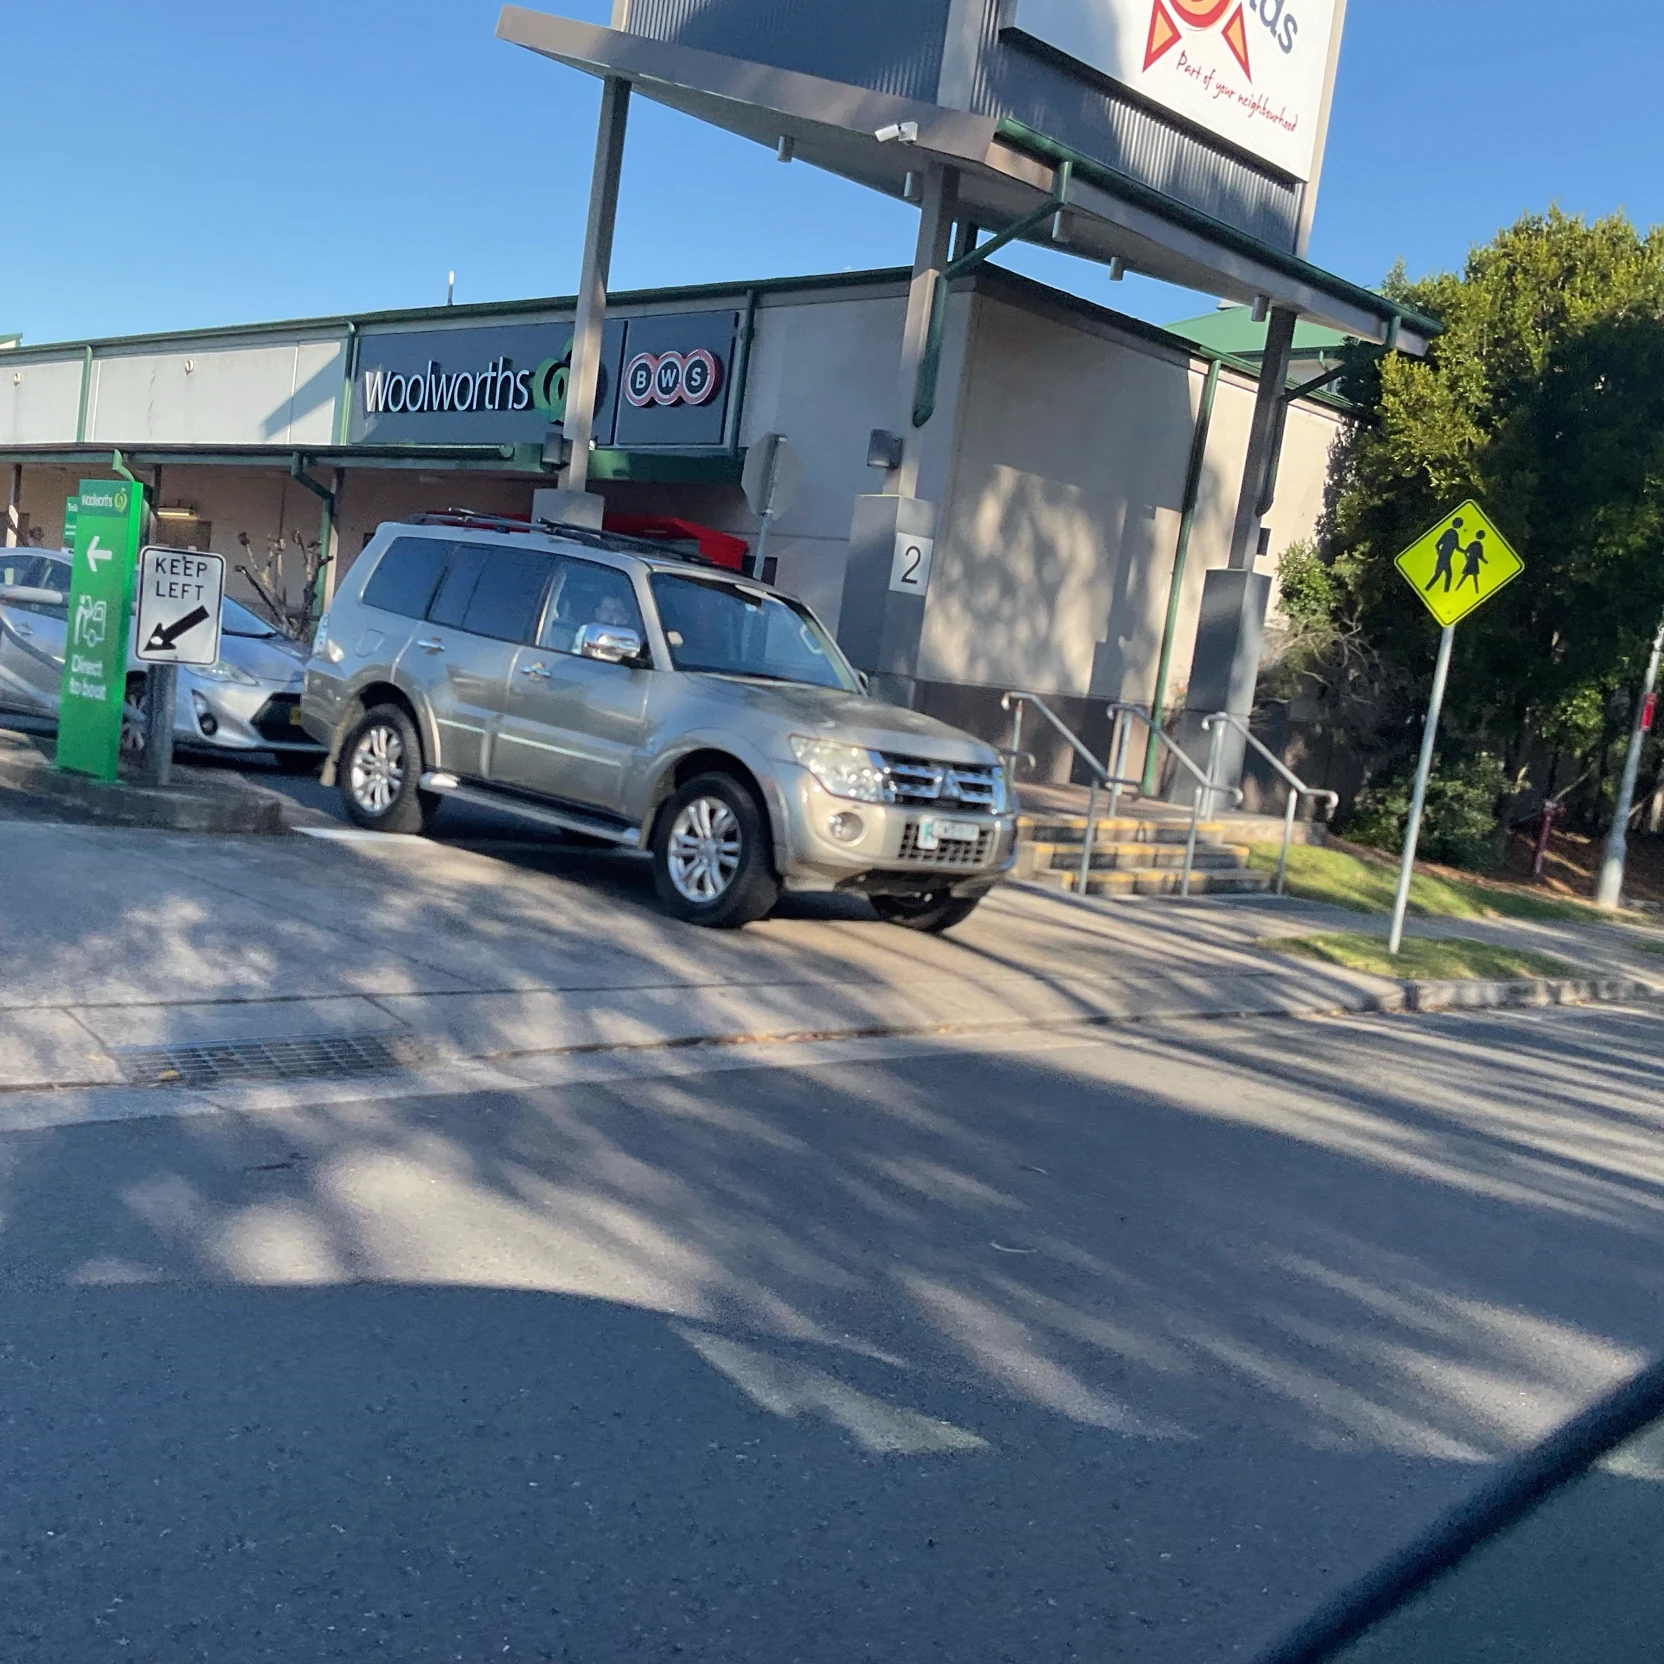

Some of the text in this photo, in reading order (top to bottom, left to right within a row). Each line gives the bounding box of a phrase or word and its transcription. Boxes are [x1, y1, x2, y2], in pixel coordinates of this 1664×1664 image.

[1249, 0, 1298, 54] ds
[1176, 50, 1298, 132] Part of your neighbourhood
[365, 356, 530, 413] Woolworths
[155, 557, 208, 578] KEEP
[900, 546, 921, 585] 2
[155, 580, 204, 601] LEFT
